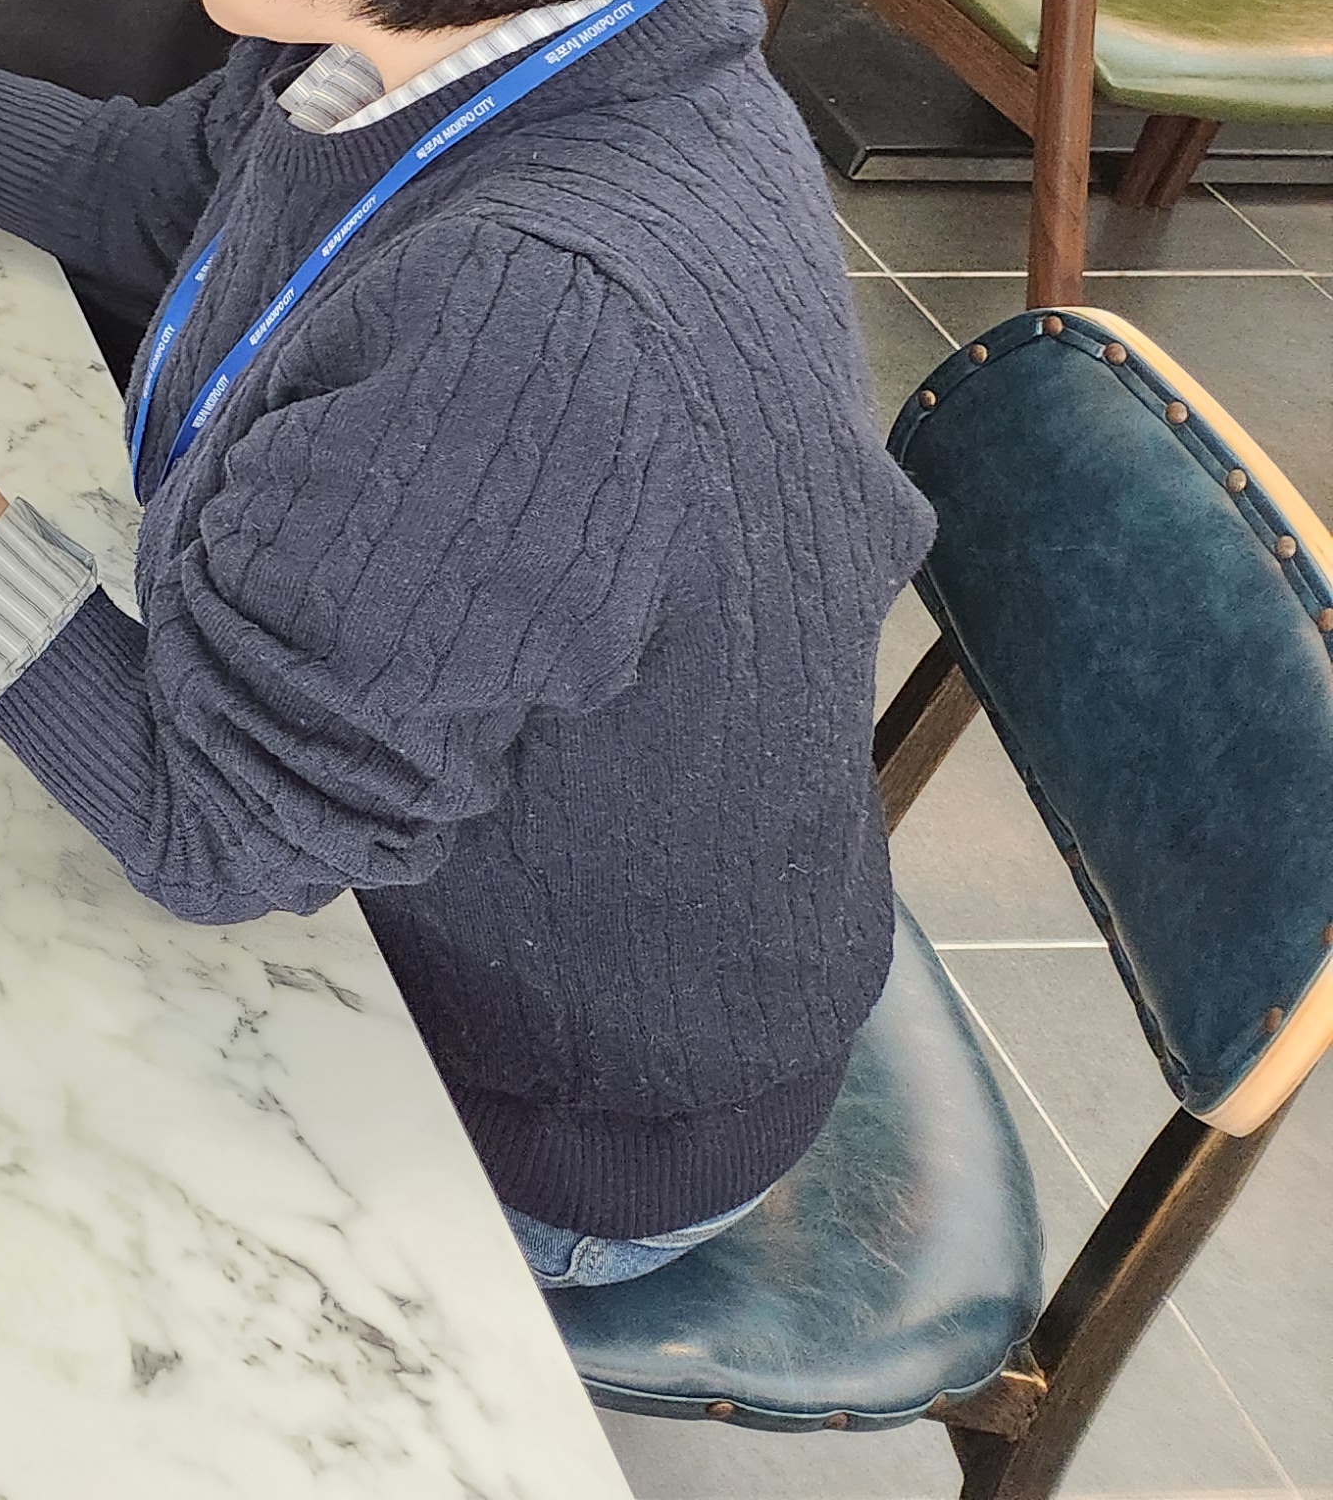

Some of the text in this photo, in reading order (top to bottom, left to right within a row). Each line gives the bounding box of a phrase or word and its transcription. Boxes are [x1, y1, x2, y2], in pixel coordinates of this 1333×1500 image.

[544, 0, 635, 65] 목포시 MOKPO CITY
[416, 95, 496, 160] 목포시 MOKPO CITY
[340, 209, 364, 238] MOKPO
[361, 193, 377, 214] CITY
[282, 286, 295, 306] CITY
[161, 323, 176, 344] CITY
[215, 373, 230, 392] CITY
